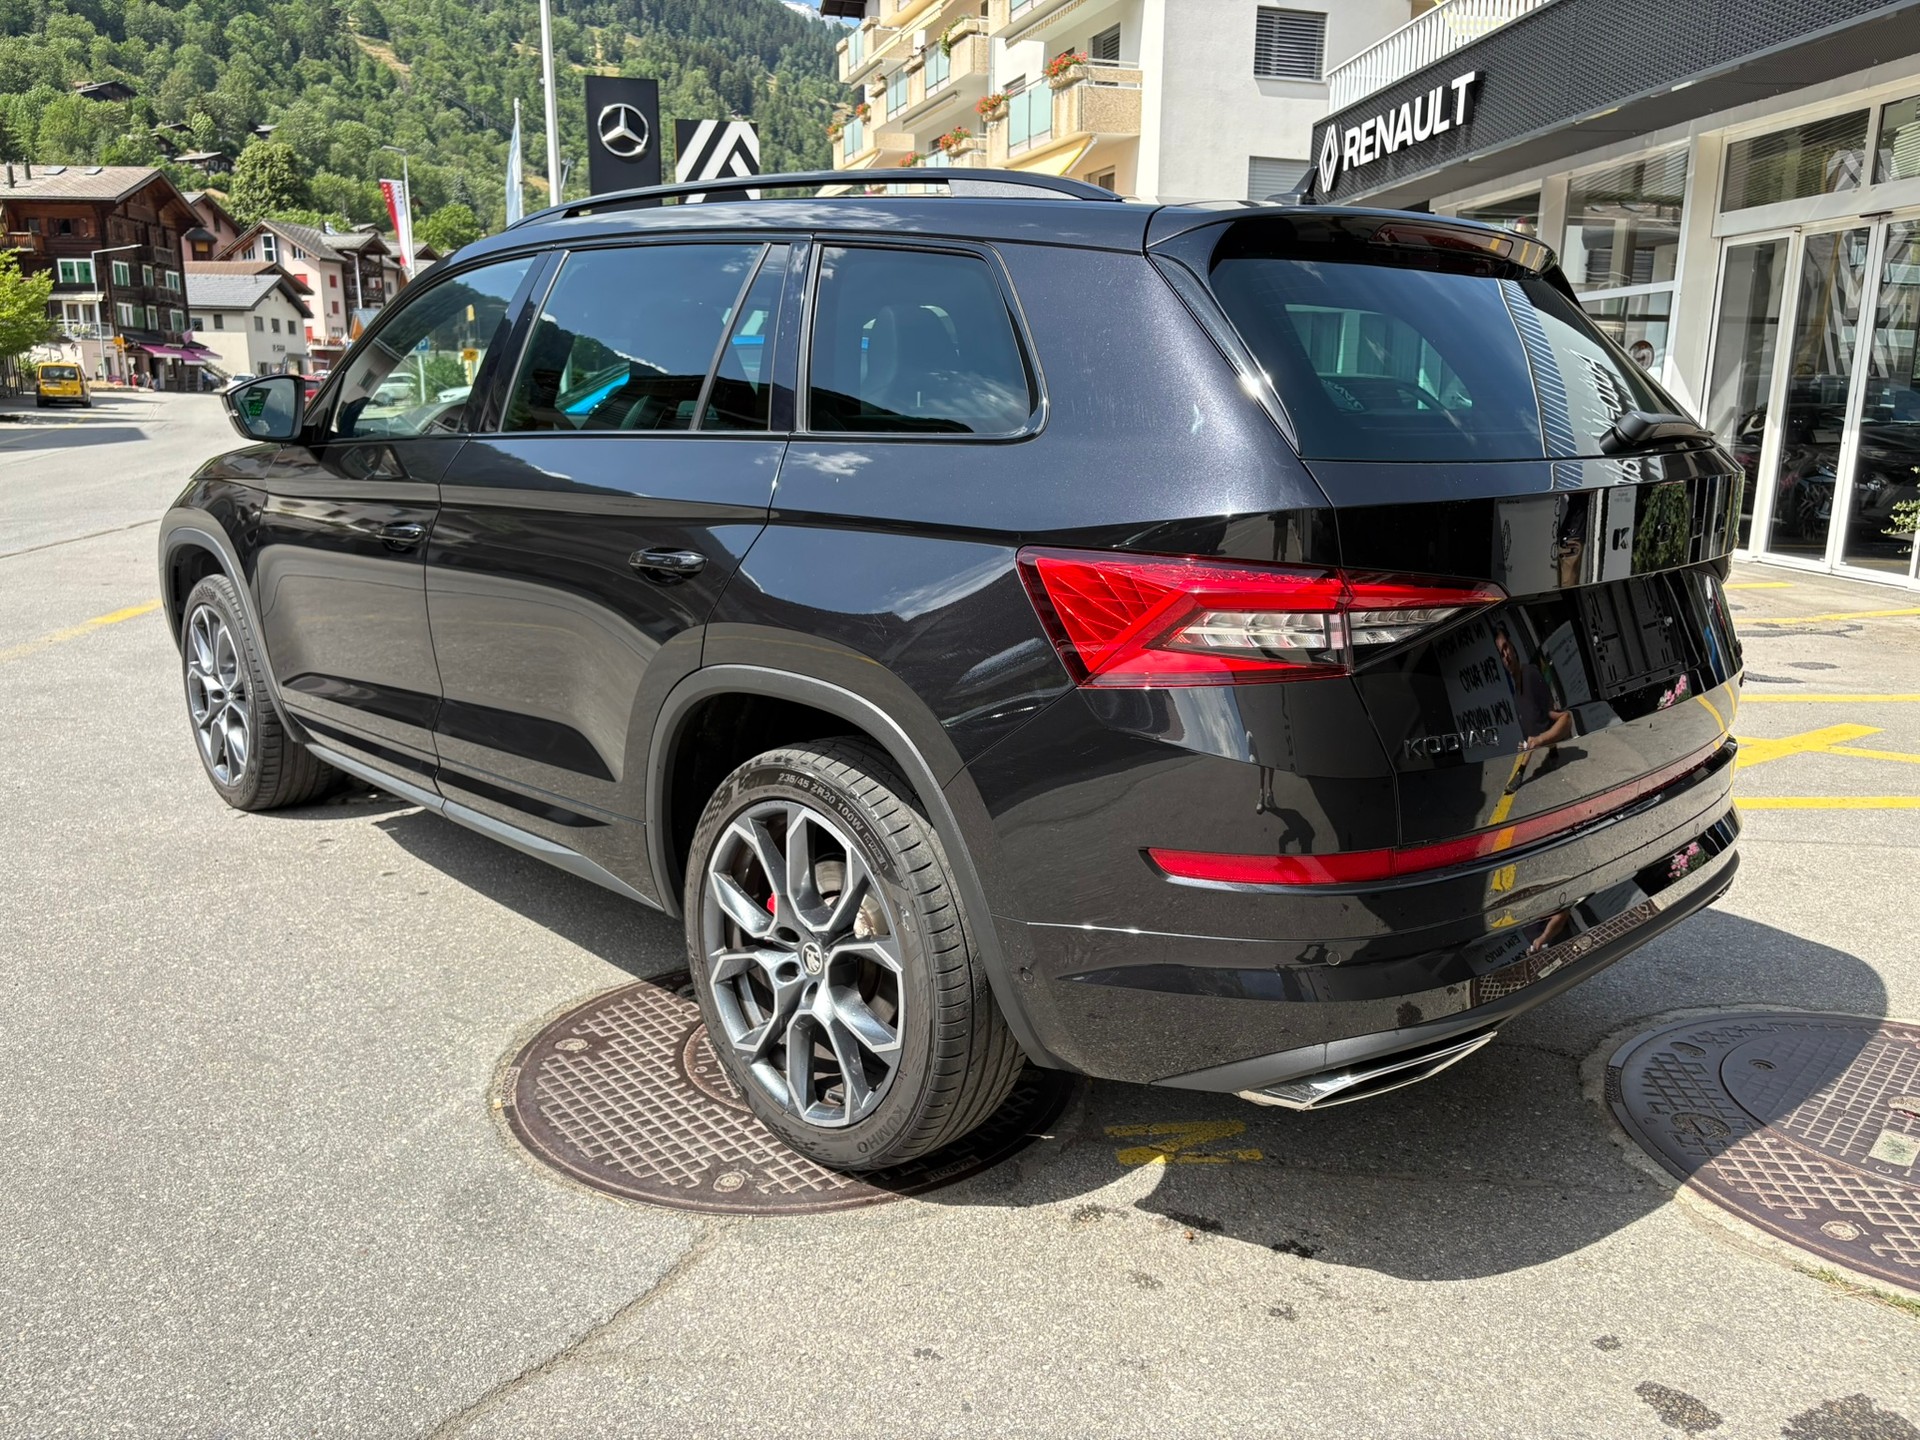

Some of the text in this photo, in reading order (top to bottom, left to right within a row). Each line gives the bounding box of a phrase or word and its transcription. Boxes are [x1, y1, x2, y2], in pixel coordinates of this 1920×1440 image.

[1343, 71, 1475, 172] RENAULT
[1403, 728, 1499, 760] KODIAQ
[778, 773, 864, 831] 235/45 ZR20 100W
[857, 1104, 907, 1154] KUMHO
